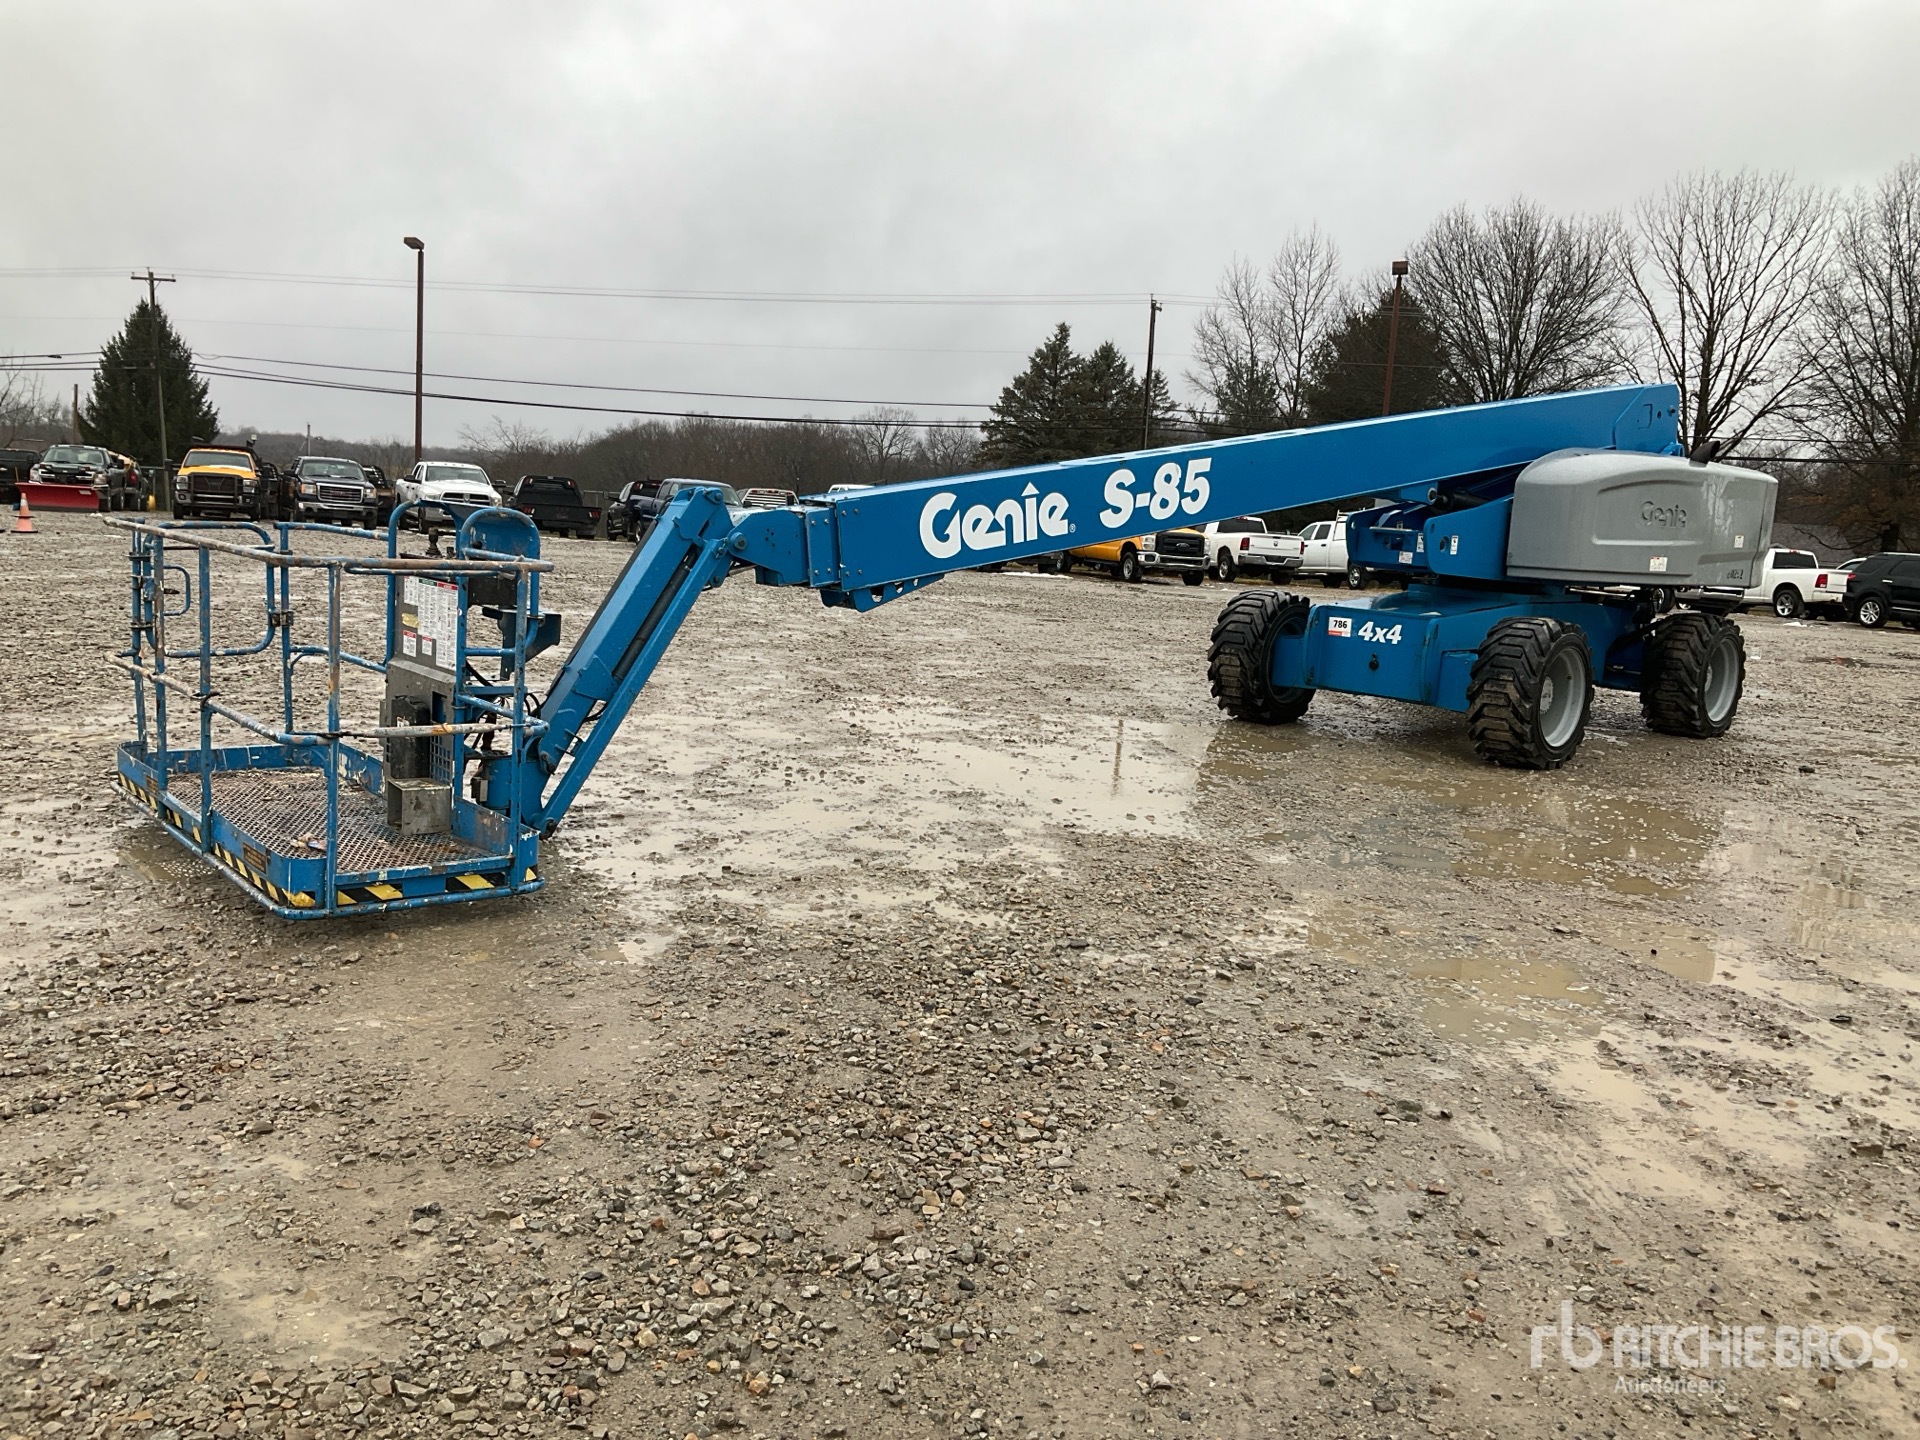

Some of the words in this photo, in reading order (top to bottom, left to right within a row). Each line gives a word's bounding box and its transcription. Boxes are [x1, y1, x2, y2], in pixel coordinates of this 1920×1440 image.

[919, 482, 1070, 559] Genie
[1099, 457, 1212, 529] S-85
[1641, 501, 1687, 528] Genie
[1333, 620, 1348, 629] 786
[1357, 621, 1403, 645] 4x4
